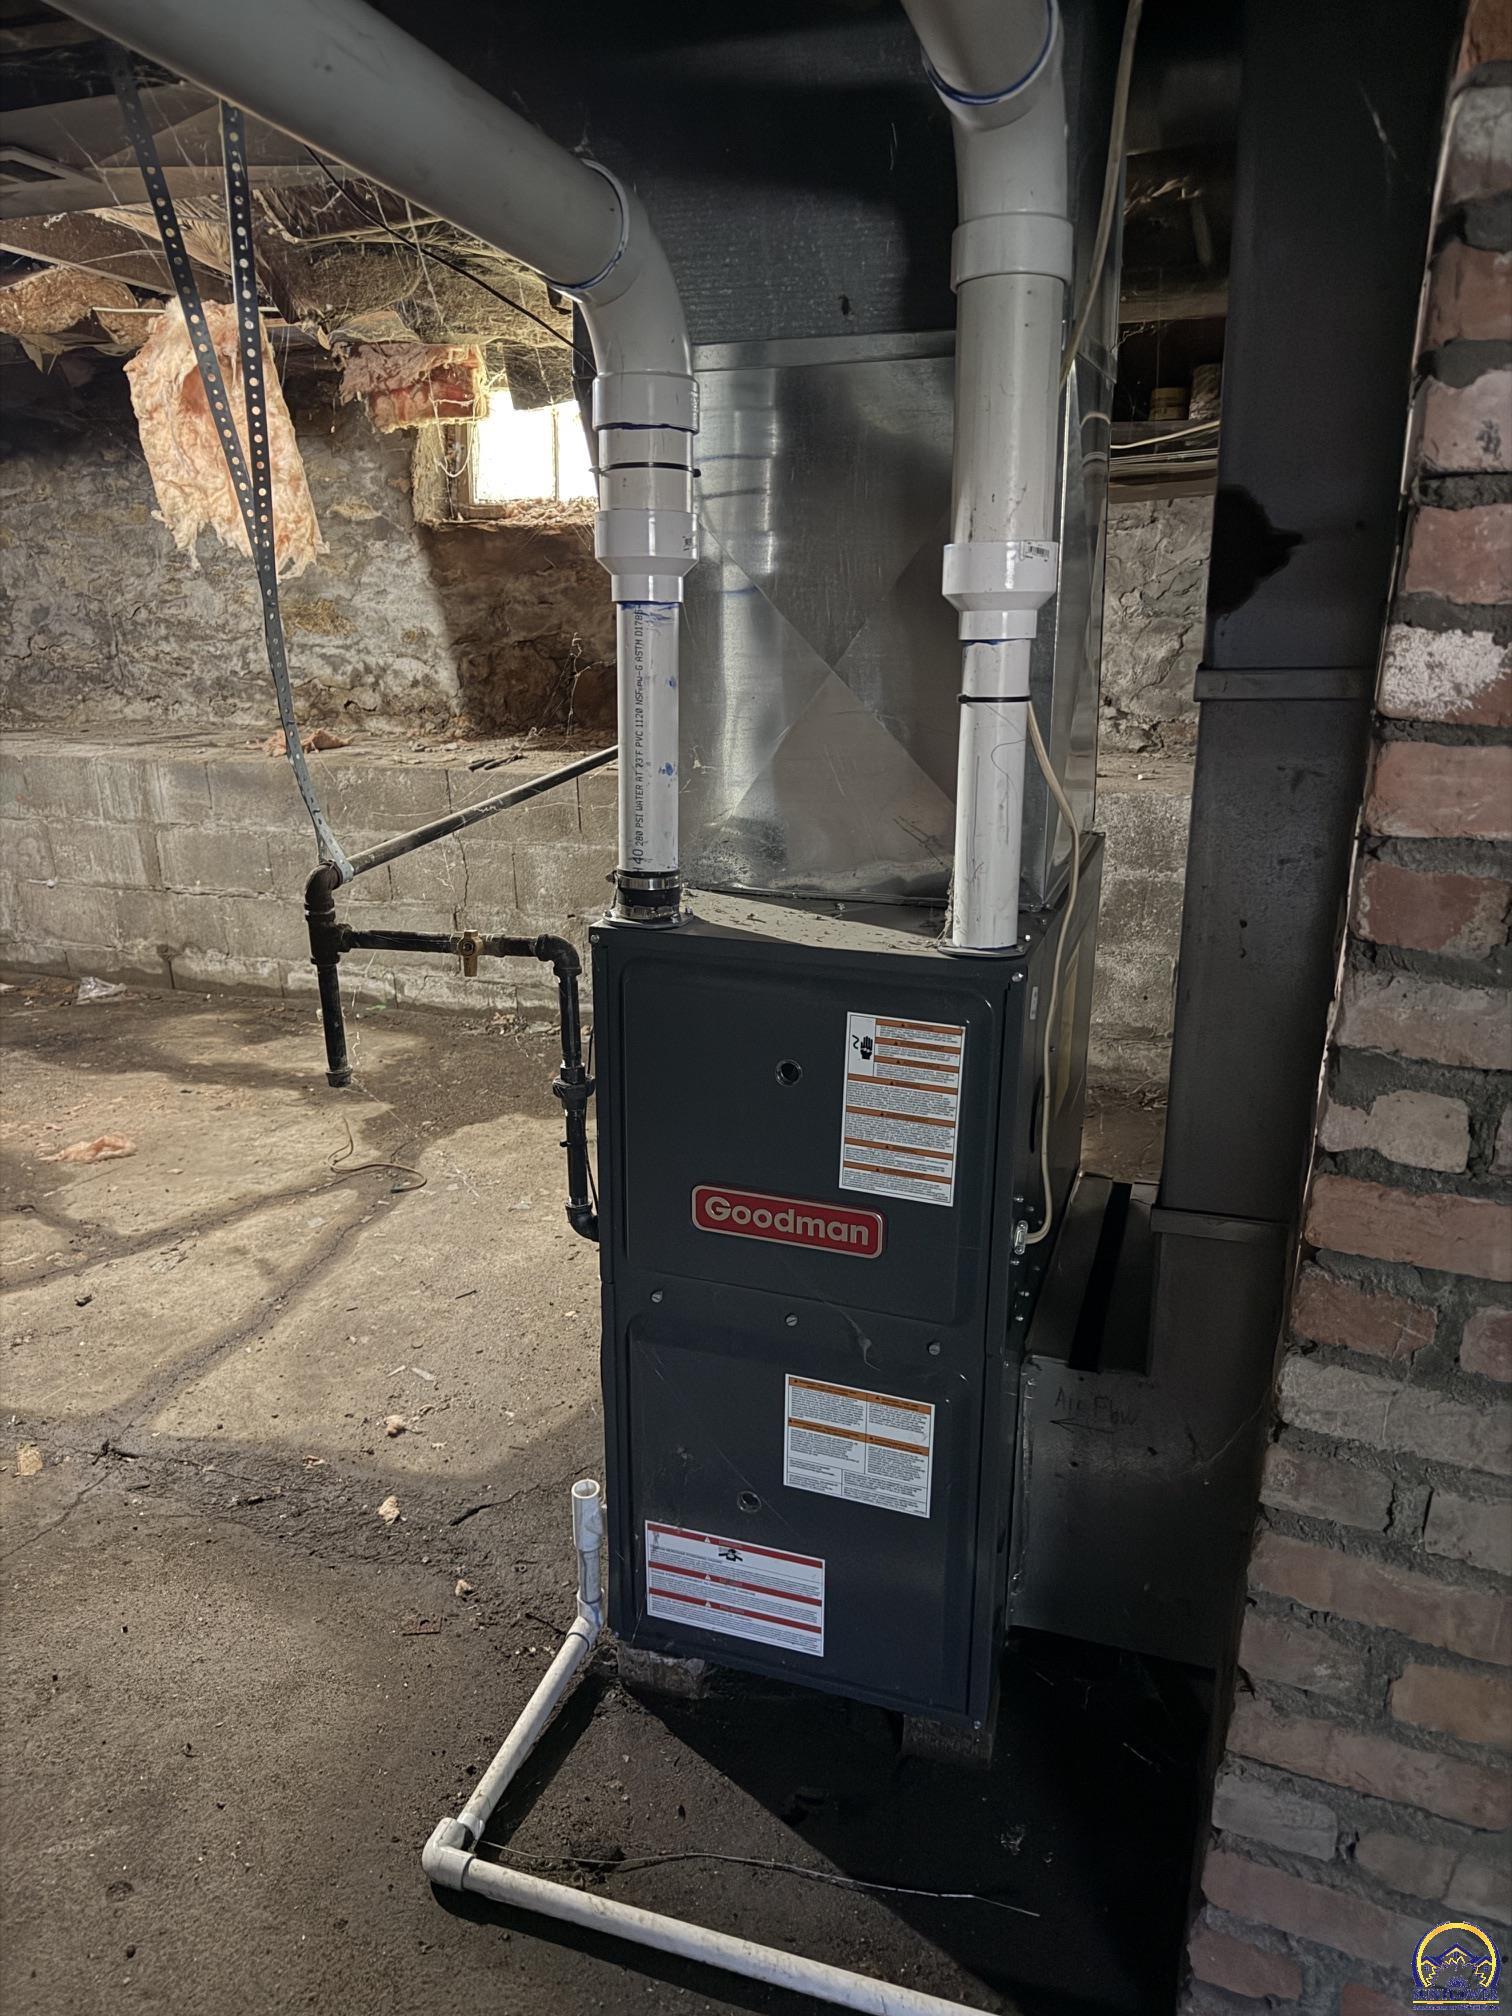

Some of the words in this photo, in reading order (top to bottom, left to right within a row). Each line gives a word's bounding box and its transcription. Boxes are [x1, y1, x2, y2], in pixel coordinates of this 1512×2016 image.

[634, 639, 643, 662] ASTM
[634, 708, 643, 728] 1120
[634, 731, 643, 747] PVC
[634, 771, 643, 782] AT
[634, 785, 643, 812] WATER
[634, 813, 643, 828] PSI
[634, 830, 644, 846] 280
[632, 848, 644, 864] 40
[704, 1196, 869, 1246] Goodman
